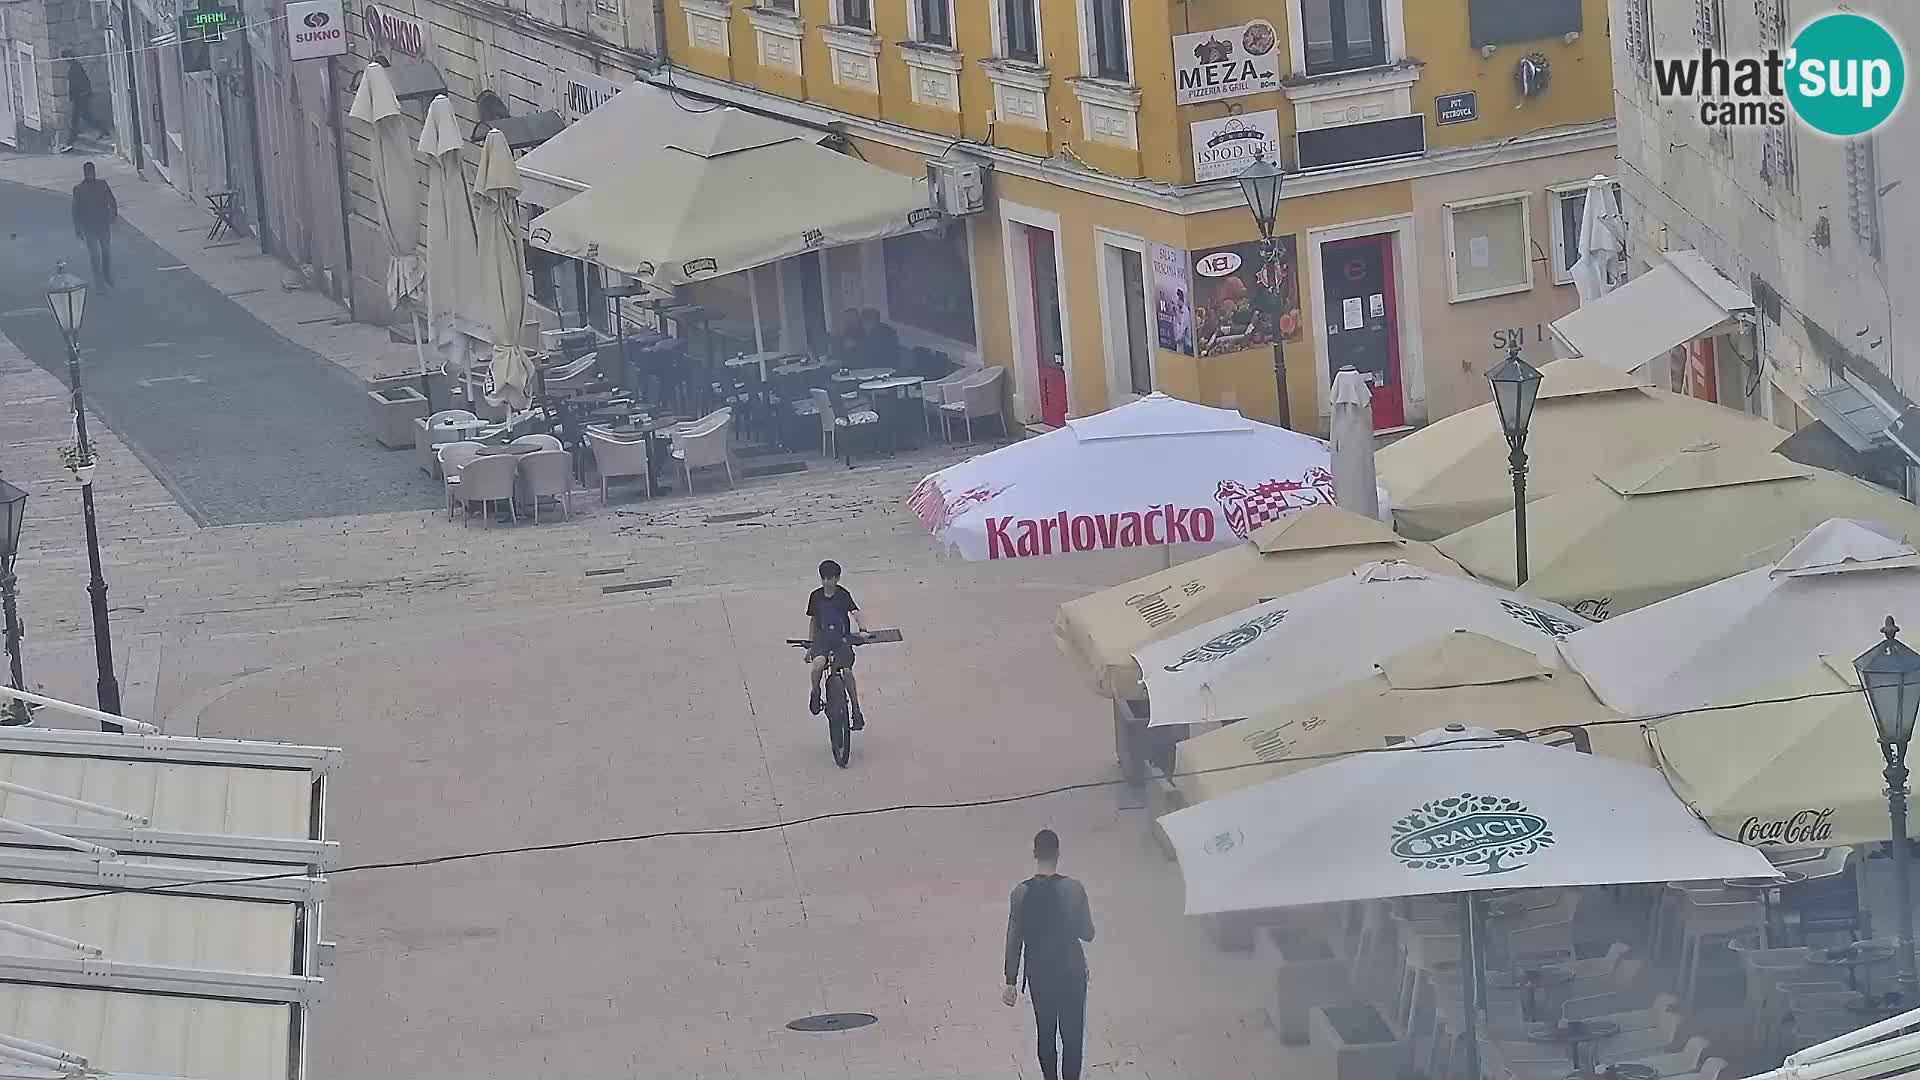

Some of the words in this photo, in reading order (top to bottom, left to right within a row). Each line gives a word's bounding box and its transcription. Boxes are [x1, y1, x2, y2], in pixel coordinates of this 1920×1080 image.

[296, 29, 340, 43] SUKNO
[382, 13, 421, 57] SUKNO
[1179, 59, 1258, 90] MEZA
[1188, 87, 1221, 98] PIZZERIA
[1198, 145, 1243, 164] ISPOD
[985, 503, 1215, 561] Karlovačko
[1430, 818, 1529, 849] RAUCH
